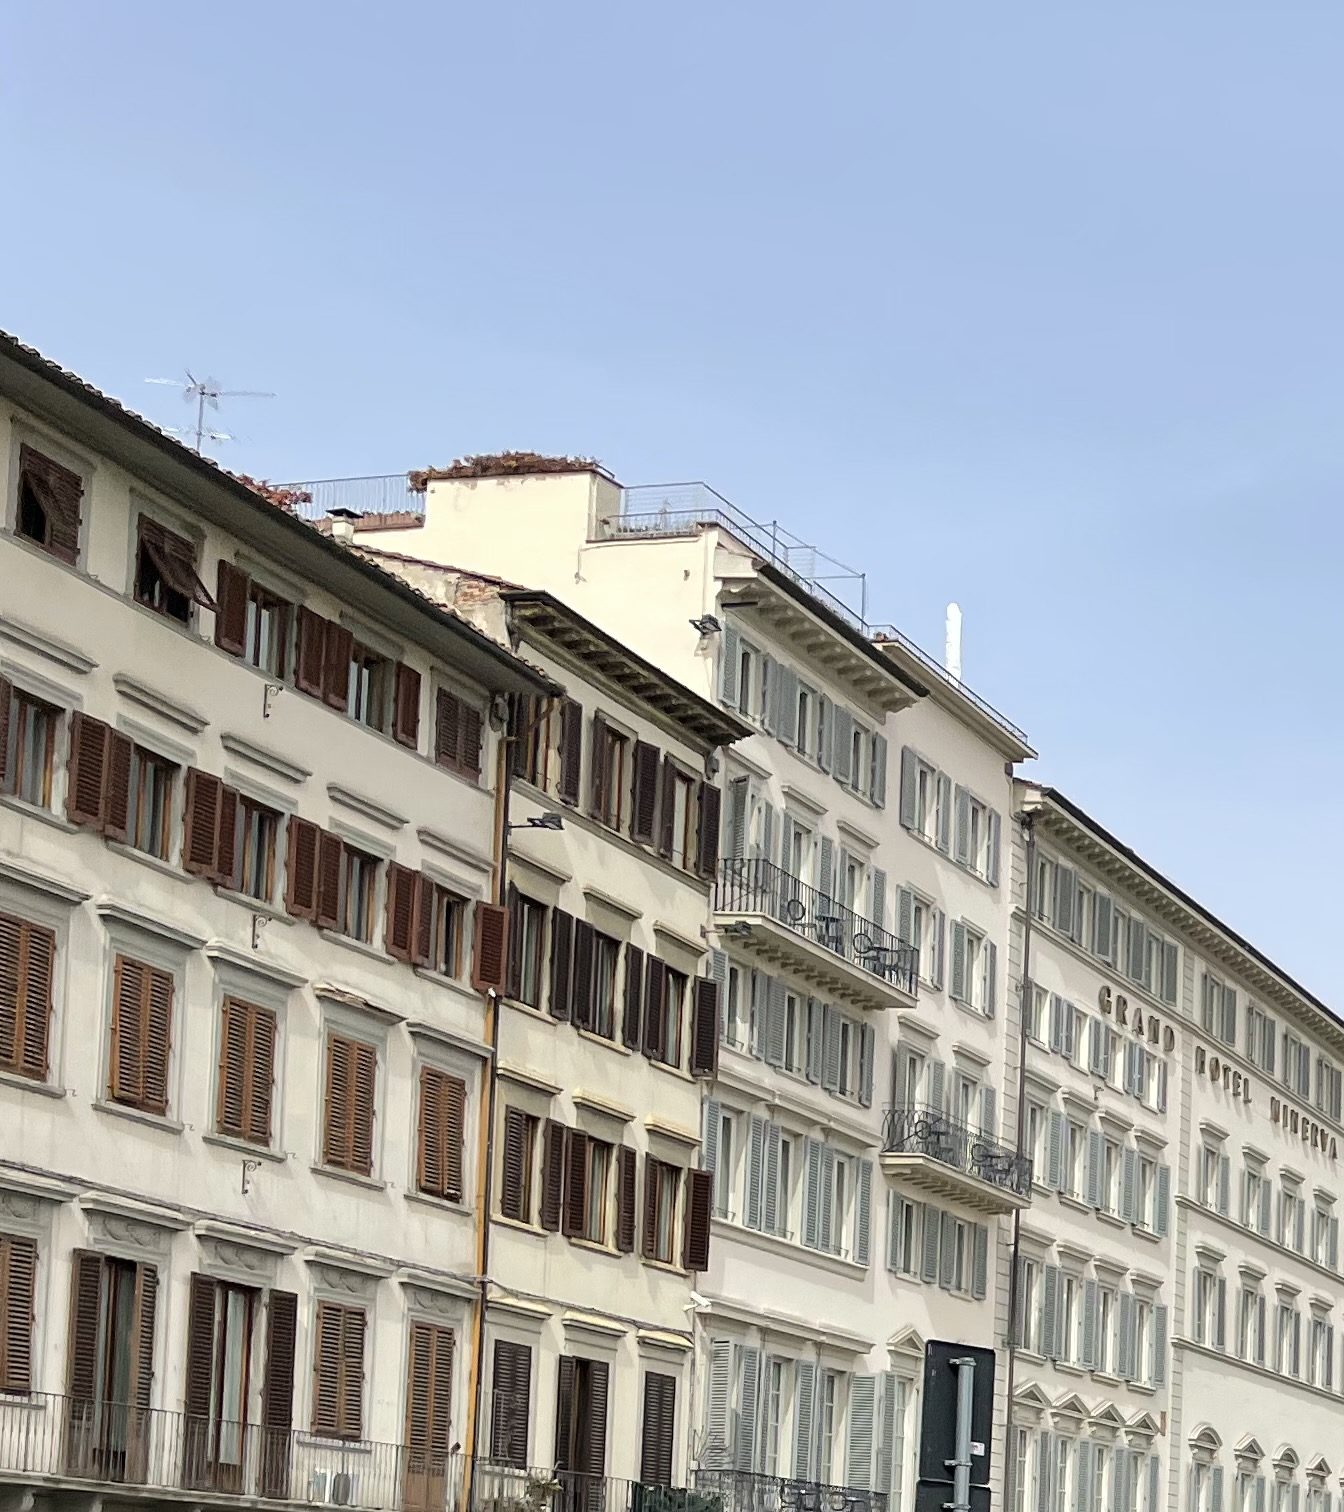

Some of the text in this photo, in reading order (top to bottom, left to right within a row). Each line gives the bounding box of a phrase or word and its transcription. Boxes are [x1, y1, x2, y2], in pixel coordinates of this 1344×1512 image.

[1098, 985, 1338, 1160] GRAND HOTEL MINERVA
